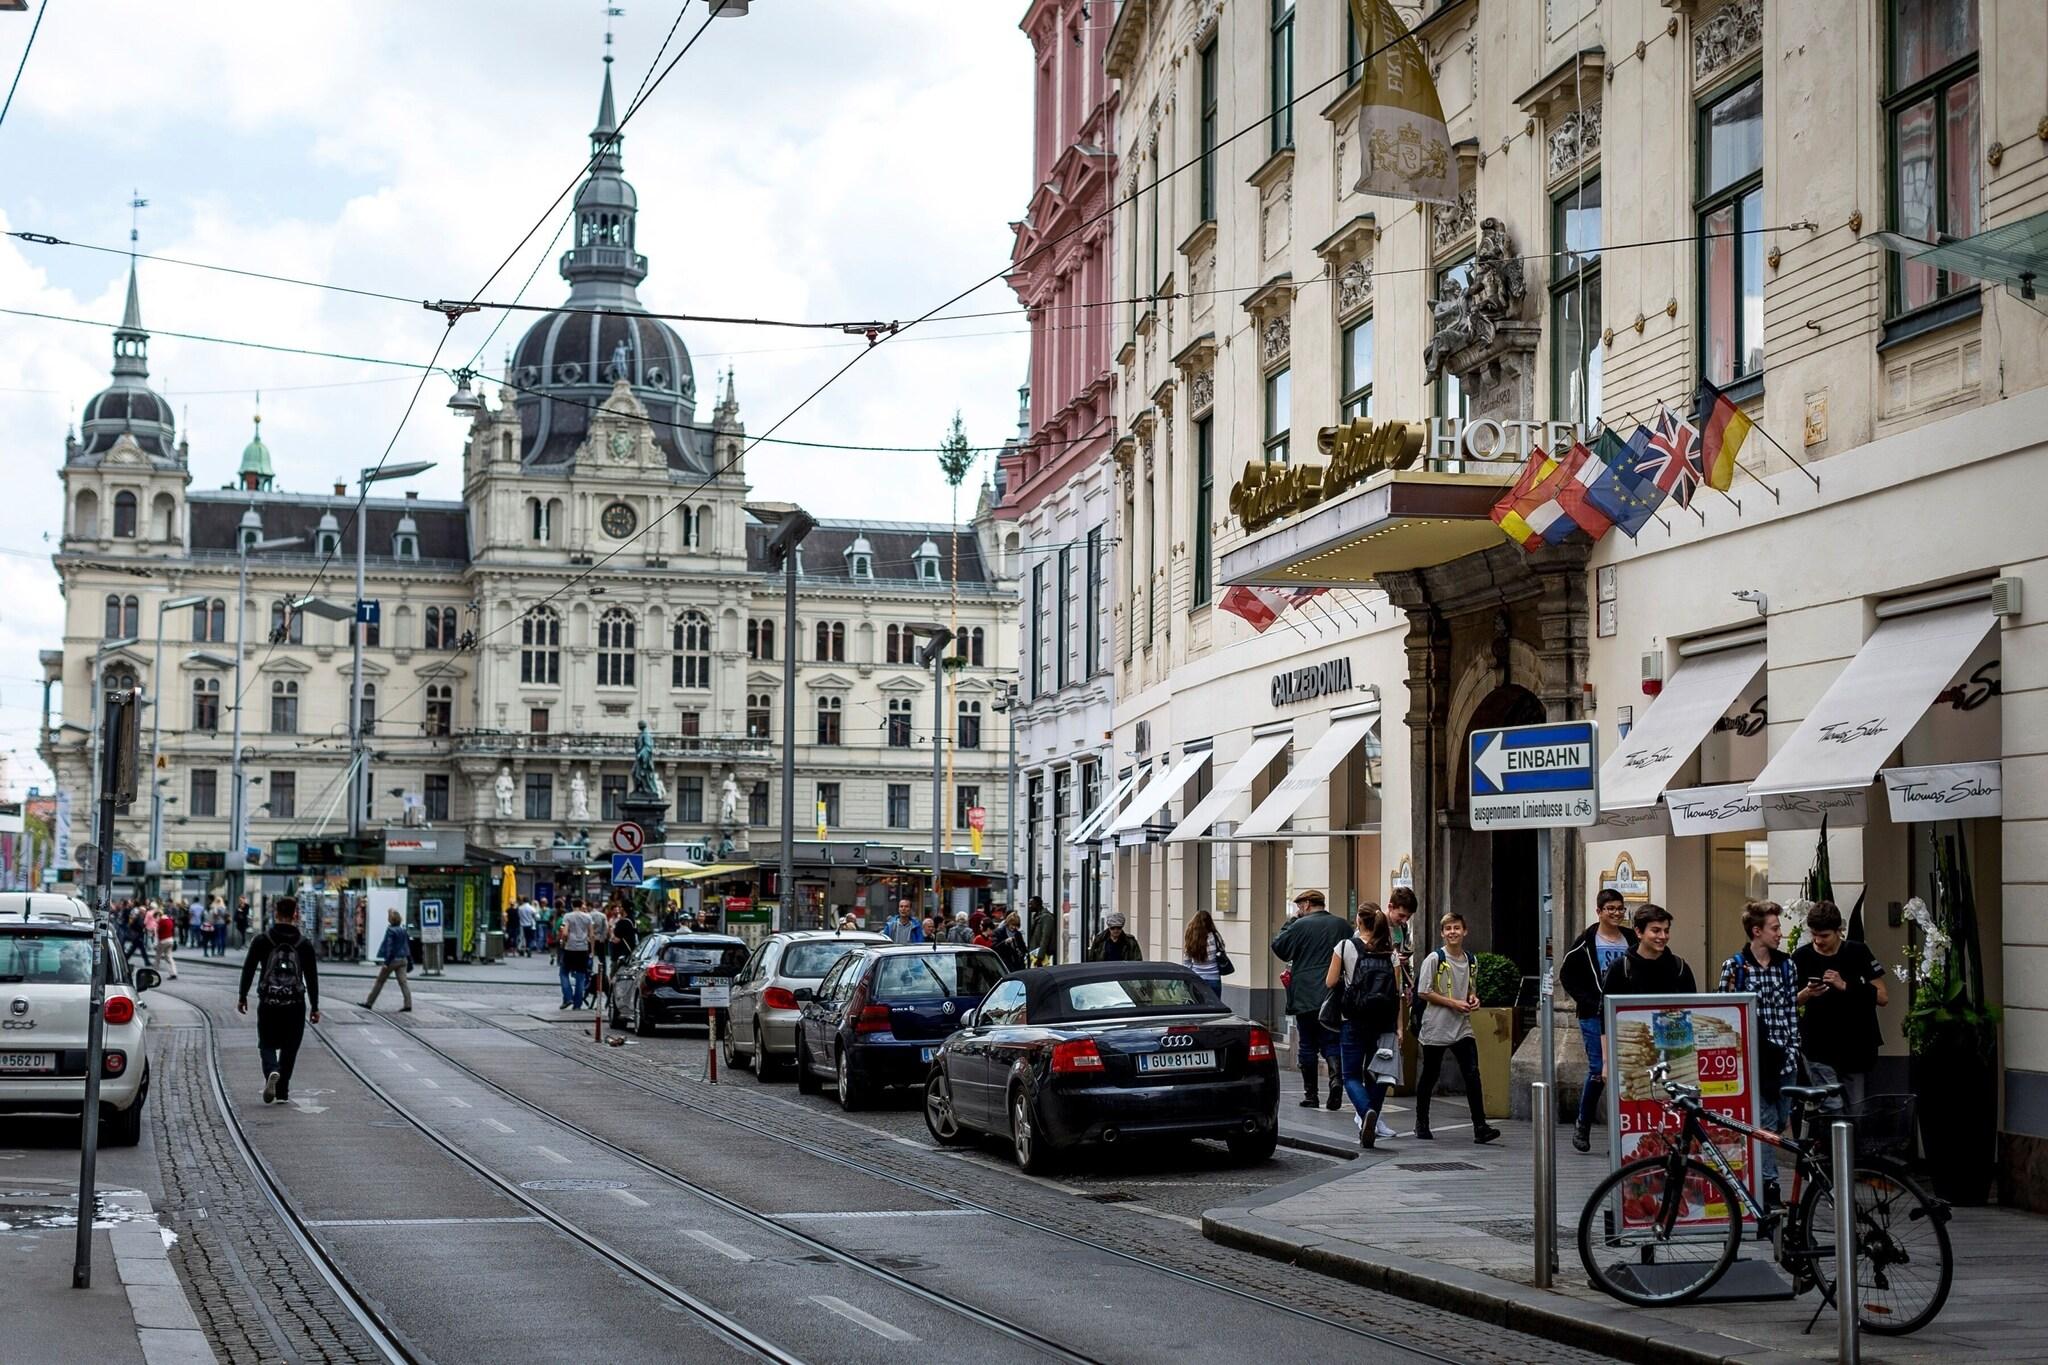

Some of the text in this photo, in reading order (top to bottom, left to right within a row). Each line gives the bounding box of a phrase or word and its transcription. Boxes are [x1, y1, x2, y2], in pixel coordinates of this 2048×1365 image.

[1271, 657, 1353, 707] CALZEDONIA
[1507, 747, 1580, 770] EINBAHN
[1890, 779, 2000, 803] Thomas Sabo
[1474, 804, 1520, 825] ausgenommen
[1523, 800, 1563, 818] Linienbusse
[1672, 797, 1762, 820] Thomas Sabo
[686, 846, 701, 860] 10
[853, 848, 860, 858] 2
[891, 851, 898, 861] 3
[9, 1055, 46, 1067] 562 DI
[1152, 1055, 1167, 1068] GU
[1699, 1055, 1737, 1076] 2.99
[1701, 1141, 1763, 1219] GENESIS
